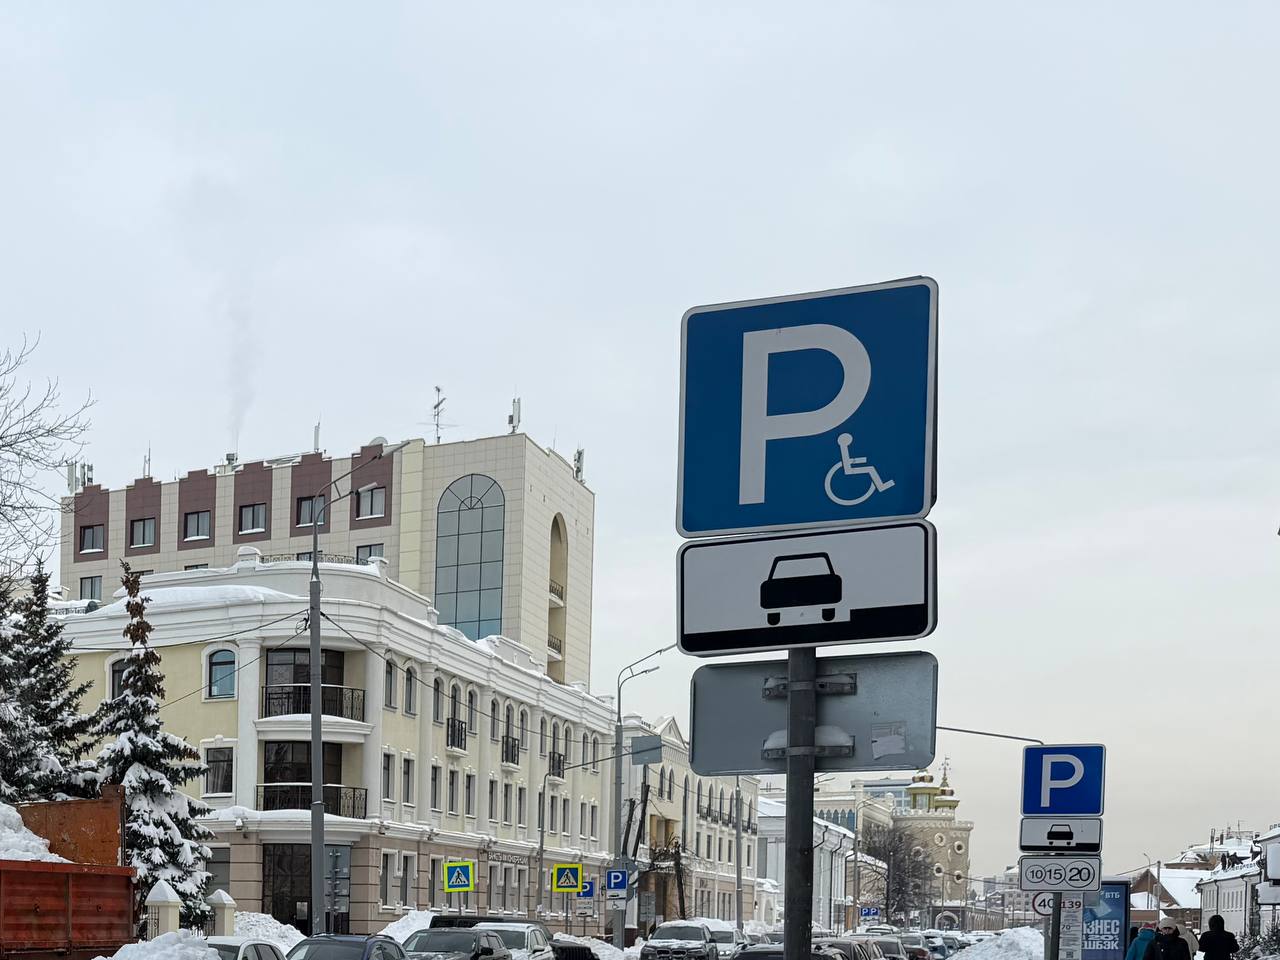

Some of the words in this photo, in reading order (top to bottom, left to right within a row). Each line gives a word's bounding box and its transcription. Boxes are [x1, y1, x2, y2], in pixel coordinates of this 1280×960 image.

[739, 323, 872, 505] P
[1040, 754, 1085, 807] P
[610, 872, 623, 888] P
[1030, 870, 1043, 879] 10
[1046, 868, 1063, 880] 15
[1068, 867, 1091, 881] 20
[579, 883, 590, 896] P
